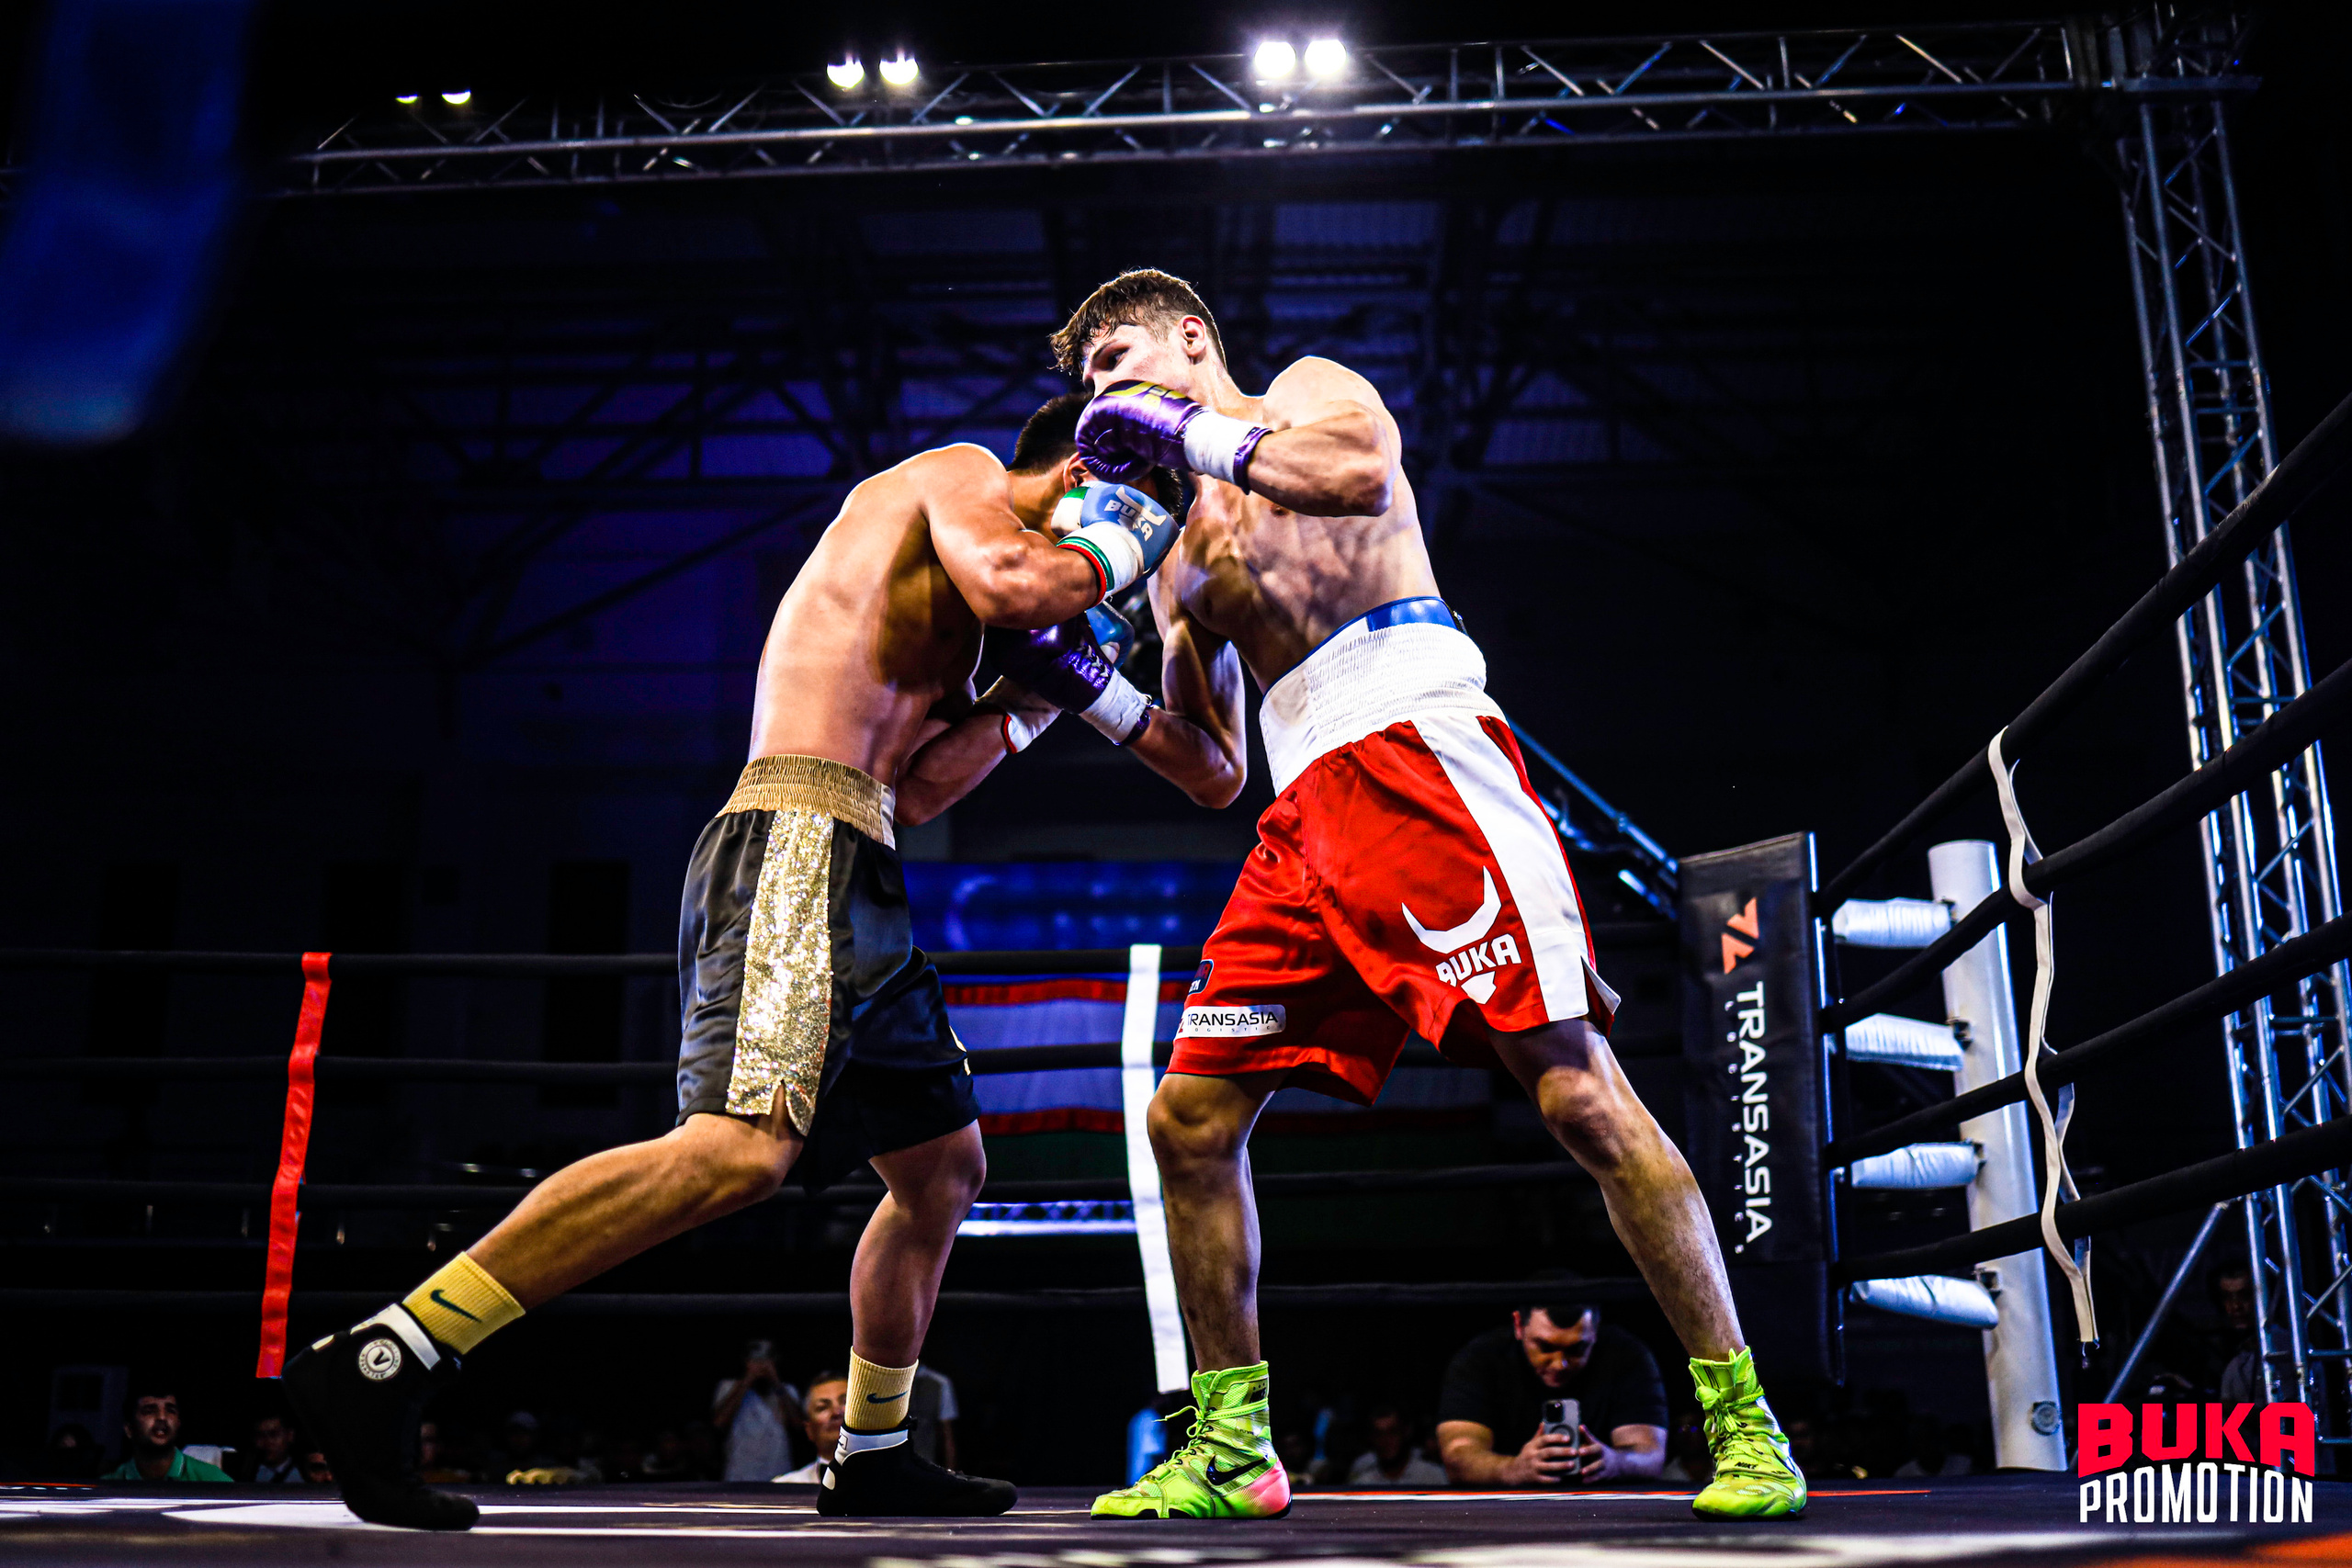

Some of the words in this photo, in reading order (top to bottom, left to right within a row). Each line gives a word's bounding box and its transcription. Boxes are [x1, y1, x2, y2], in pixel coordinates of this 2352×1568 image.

[1435, 932, 1522, 987] BUKA
[1724, 999, 1745, 1255] LOGISTICS
[1736, 980, 1772, 1244] TRANSASIA
